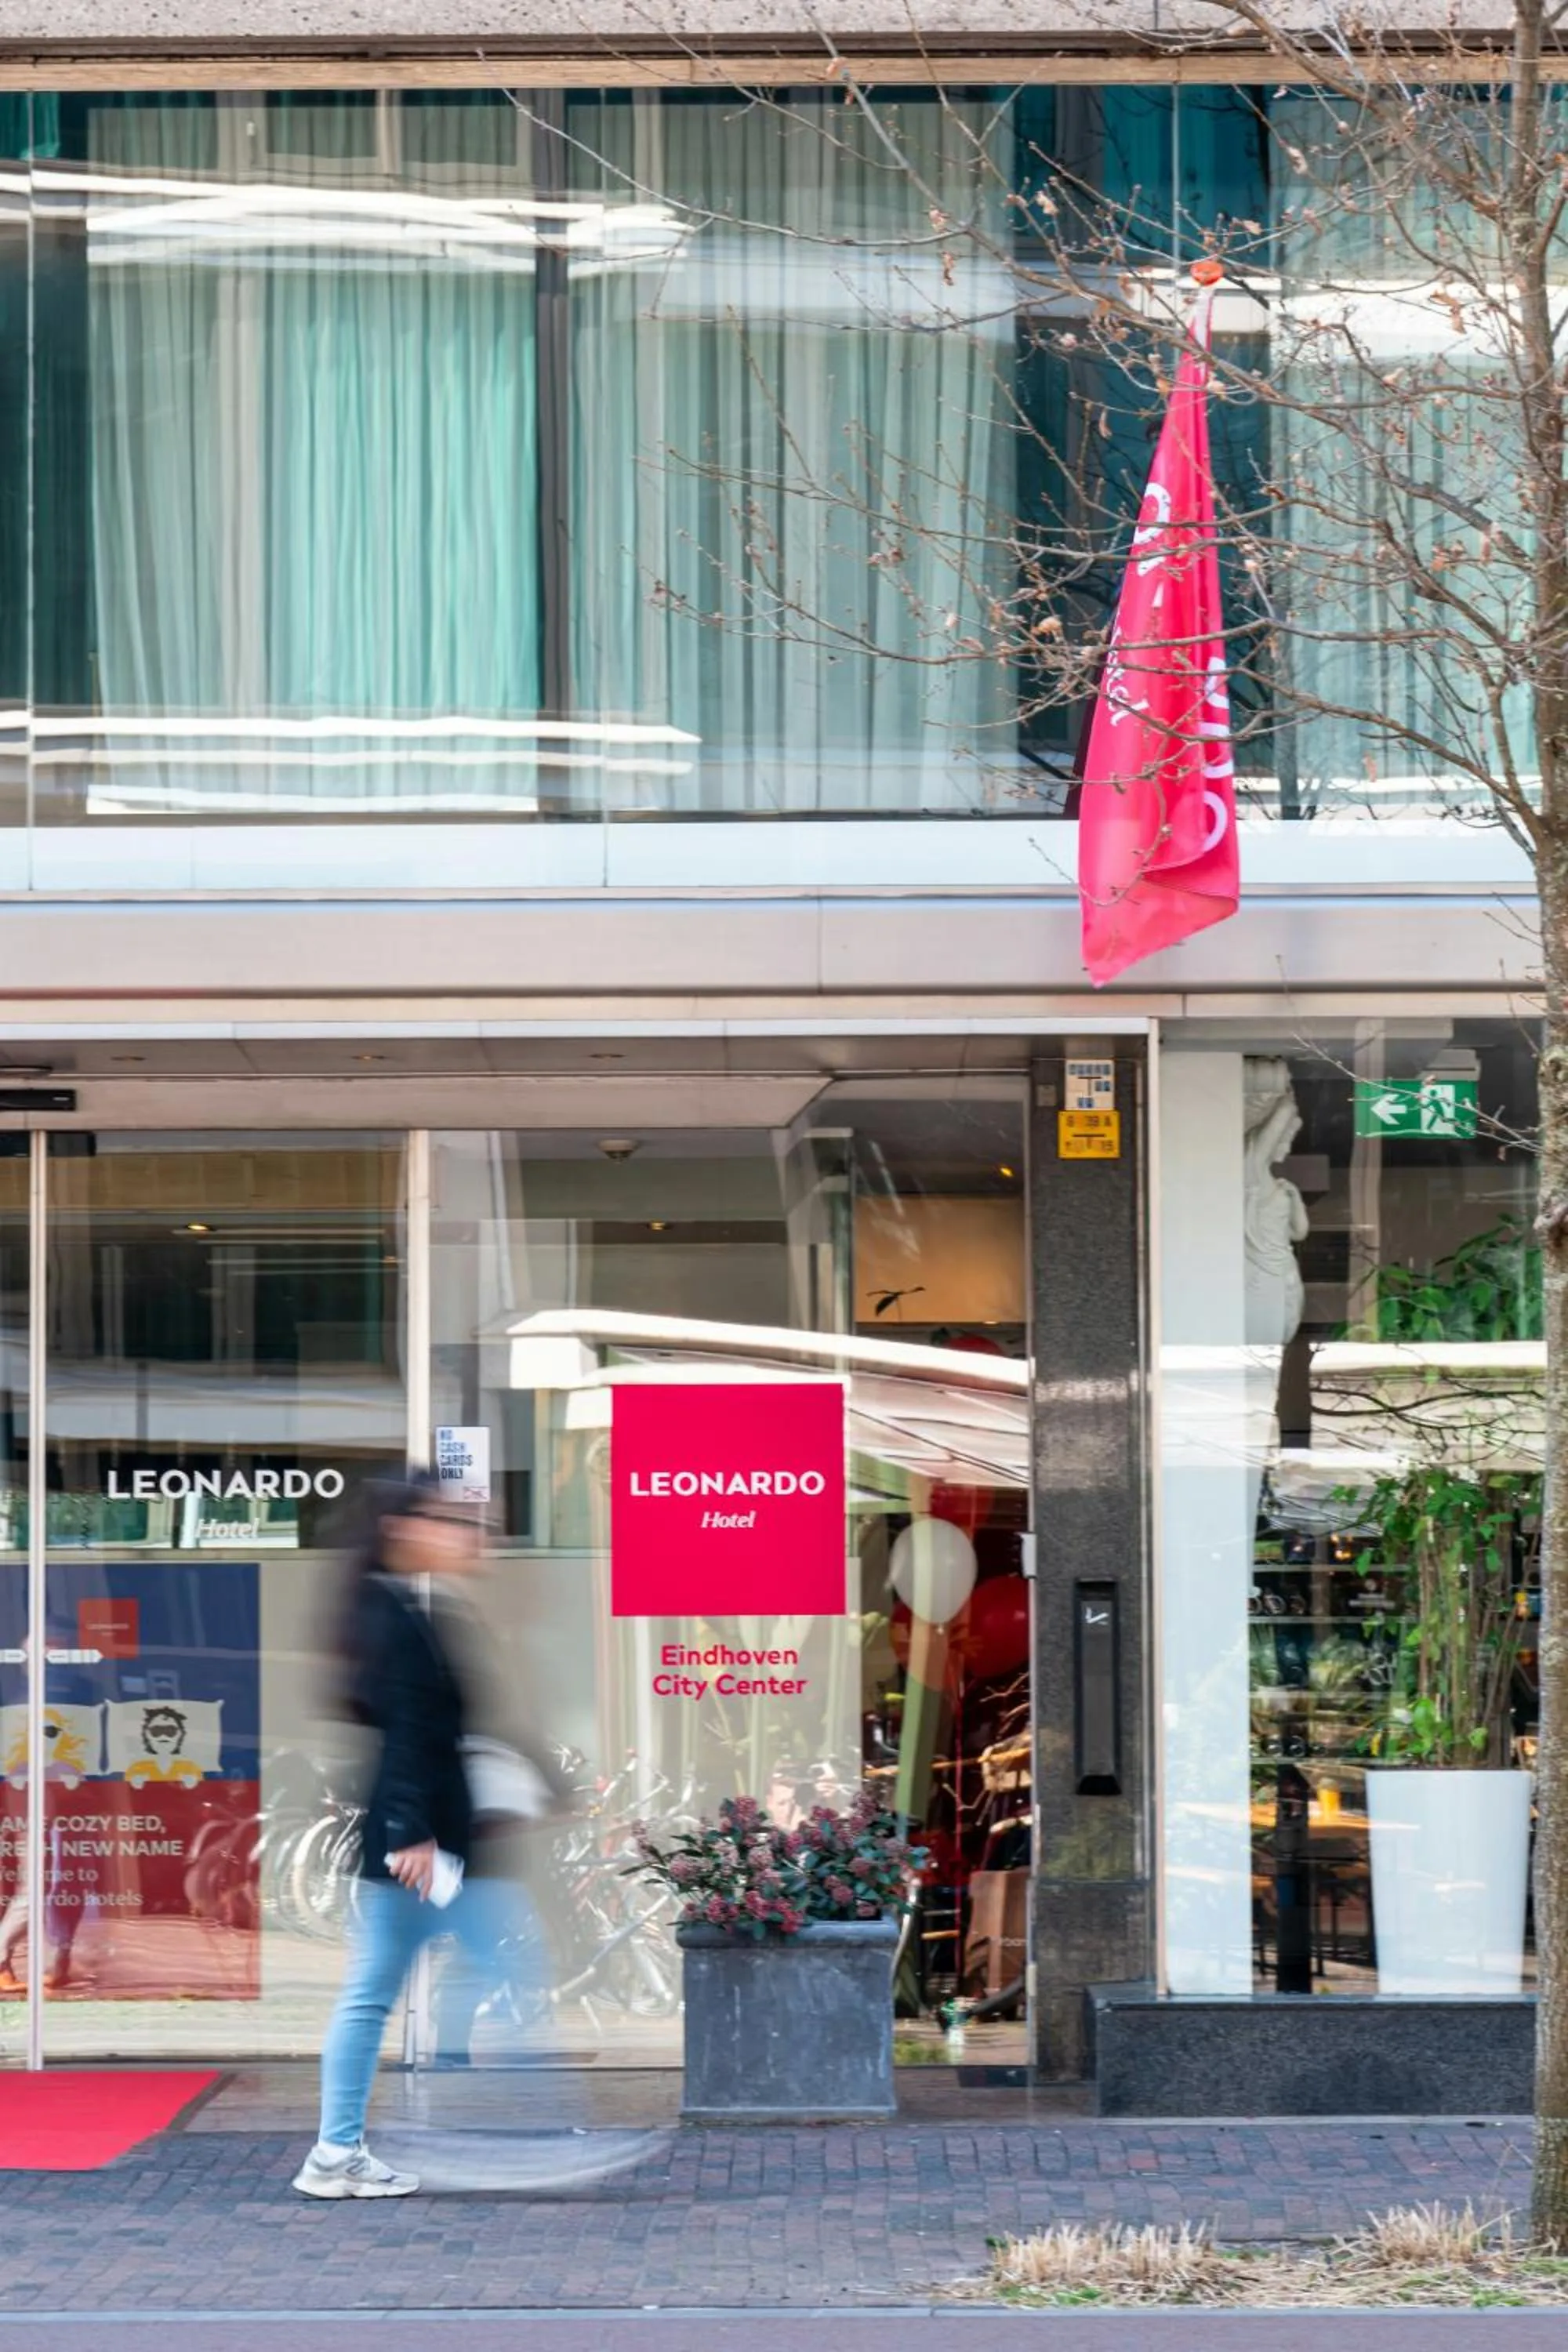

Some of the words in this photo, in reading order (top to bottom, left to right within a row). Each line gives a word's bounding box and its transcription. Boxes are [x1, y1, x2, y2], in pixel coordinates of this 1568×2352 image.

[107, 1468, 344, 1498] LEONARDO
[441, 1468, 463, 1479] ONLY
[630, 1471, 825, 1496] LEONARDO
[196, 1517, 260, 1538] Hotel
[701, 1511, 757, 1528] Hotel
[661, 1644, 797, 1666] Eindhoven
[652, 1674, 708, 1700] City
[716, 1674, 807, 1695] Center
[53, 1815, 111, 1832] COZY
[118, 1815, 166, 1834] BED,
[63, 1840, 111, 1856] NEW
[119, 1840, 183, 1856] NAME
[78, 1868, 98, 1882] to
[84, 1889, 143, 1906] hotels
